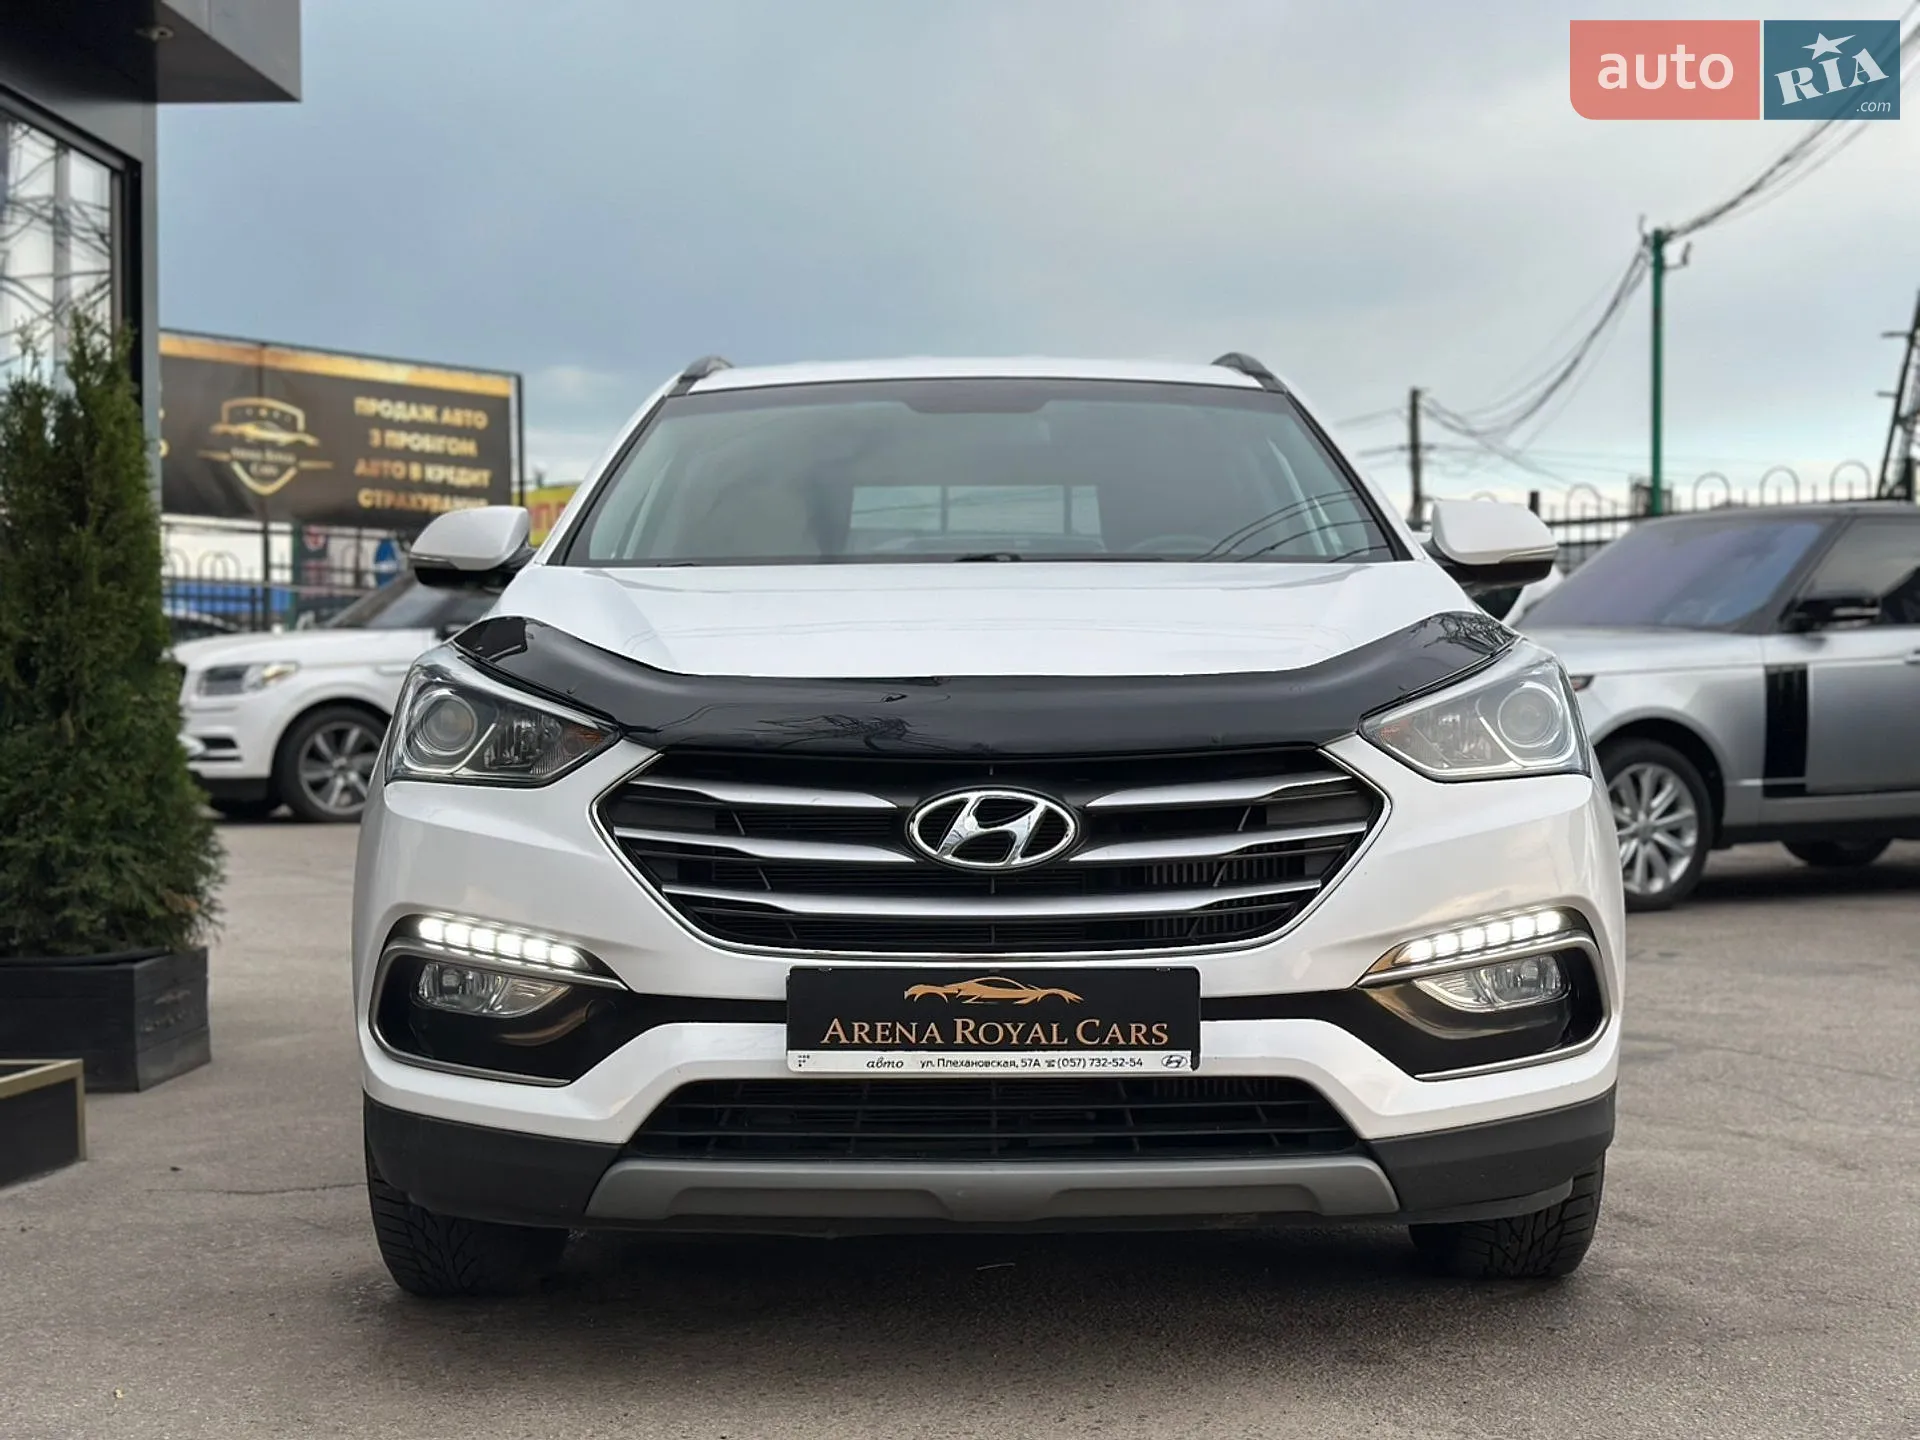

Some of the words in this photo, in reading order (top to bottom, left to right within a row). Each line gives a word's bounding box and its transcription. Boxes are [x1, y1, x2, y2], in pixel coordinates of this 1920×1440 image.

[354, 397, 438, 423] ПРОДАЖ
[440, 406, 489, 430] АВТО
[384, 429, 478, 458] ПРОБІГОМ
[354, 458, 407, 480] АВТО
[409, 461, 422, 482] В
[424, 463, 492, 488] КРЕДИТ
[820, 1017, 945, 1044] ARENA
[953, 1018, 1068, 1045] ROYAL
[1075, 1018, 1169, 1046] CARS
[937, 1058, 1018, 1069] Плехановская,
[1057, 1057, 1086, 1069] (057)
[1089, 1057, 1143, 1068] 732-52-54
